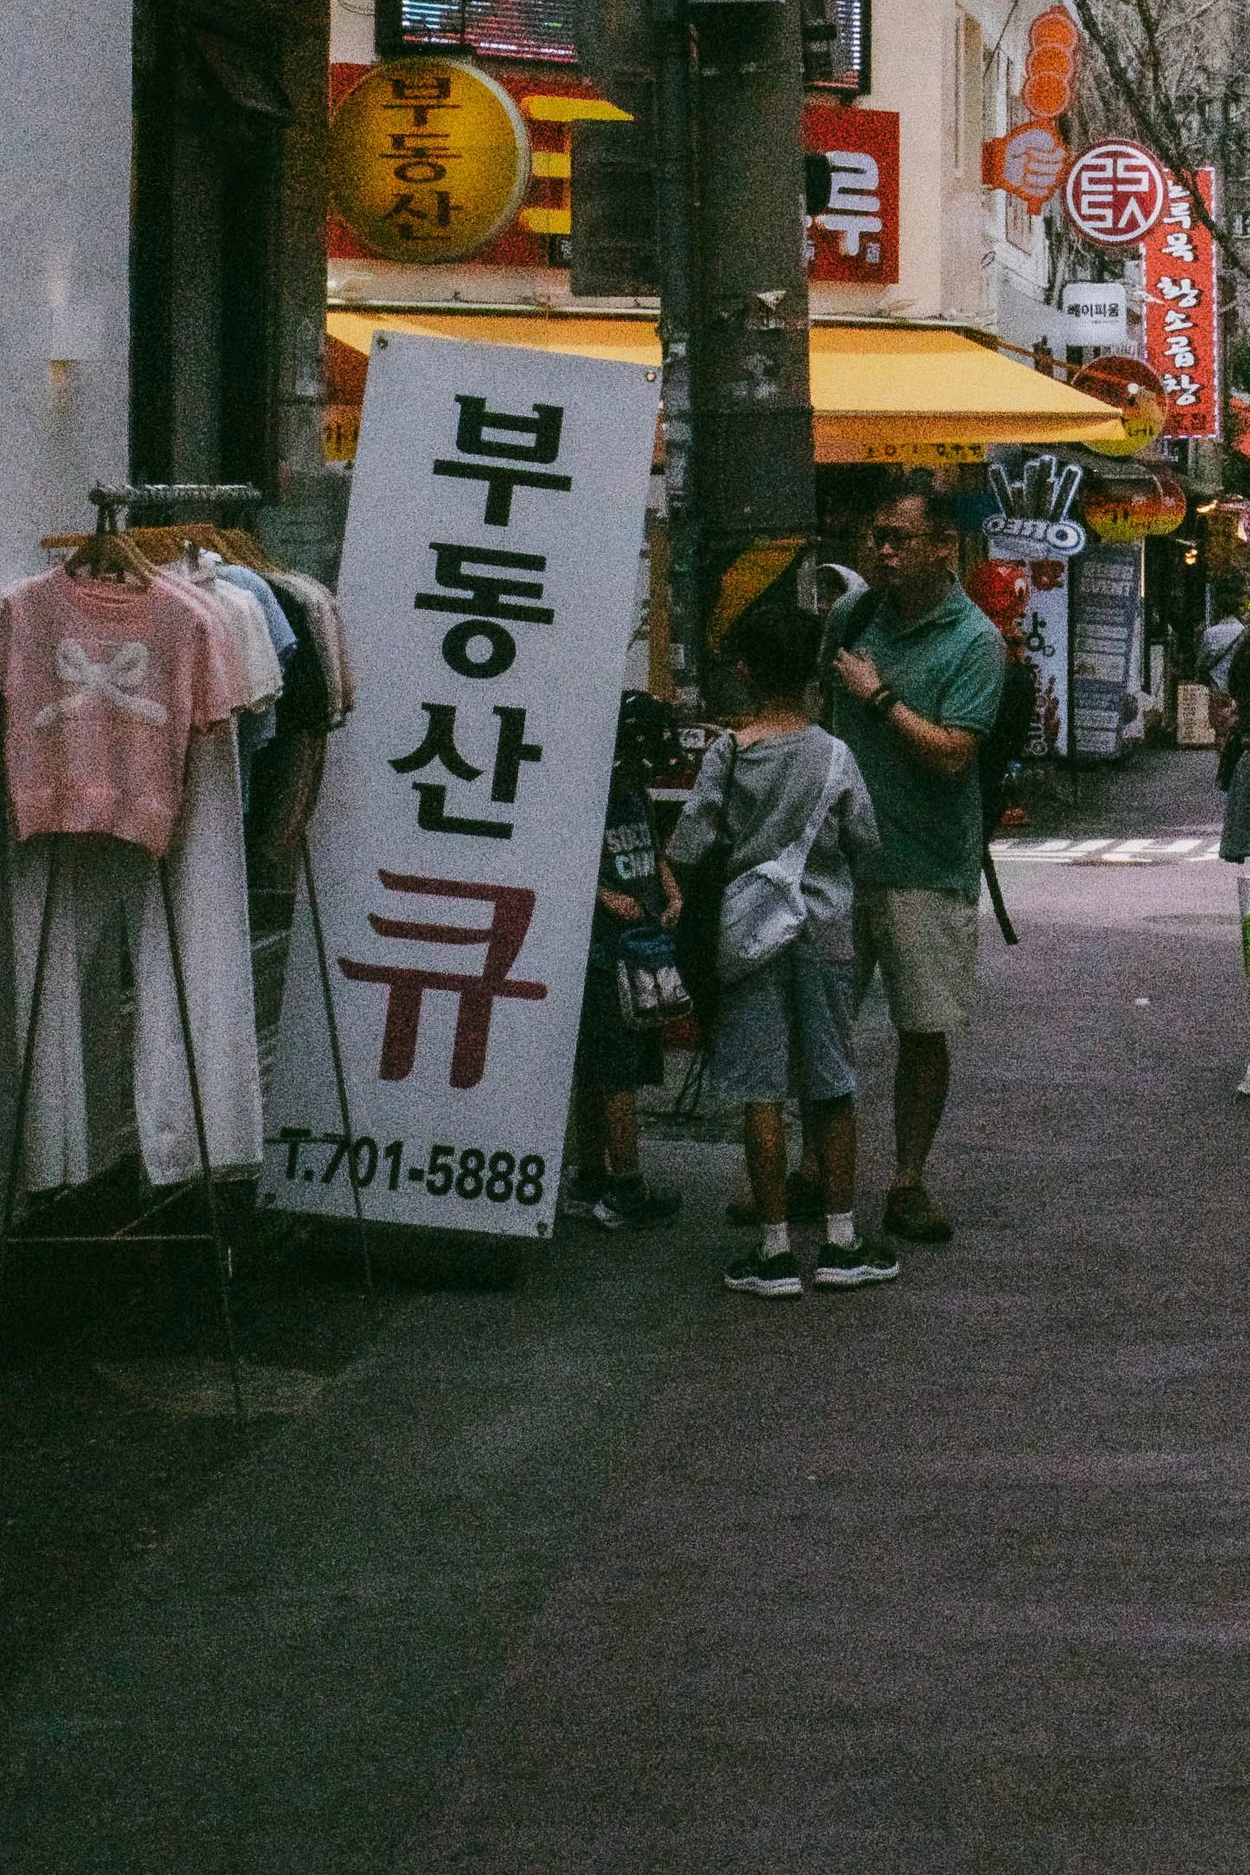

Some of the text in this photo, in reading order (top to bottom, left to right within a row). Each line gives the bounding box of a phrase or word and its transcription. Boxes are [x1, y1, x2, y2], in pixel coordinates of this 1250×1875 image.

[381, 77, 465, 243] 부동산
[338, 393, 573, 1089] 부동산 큐
